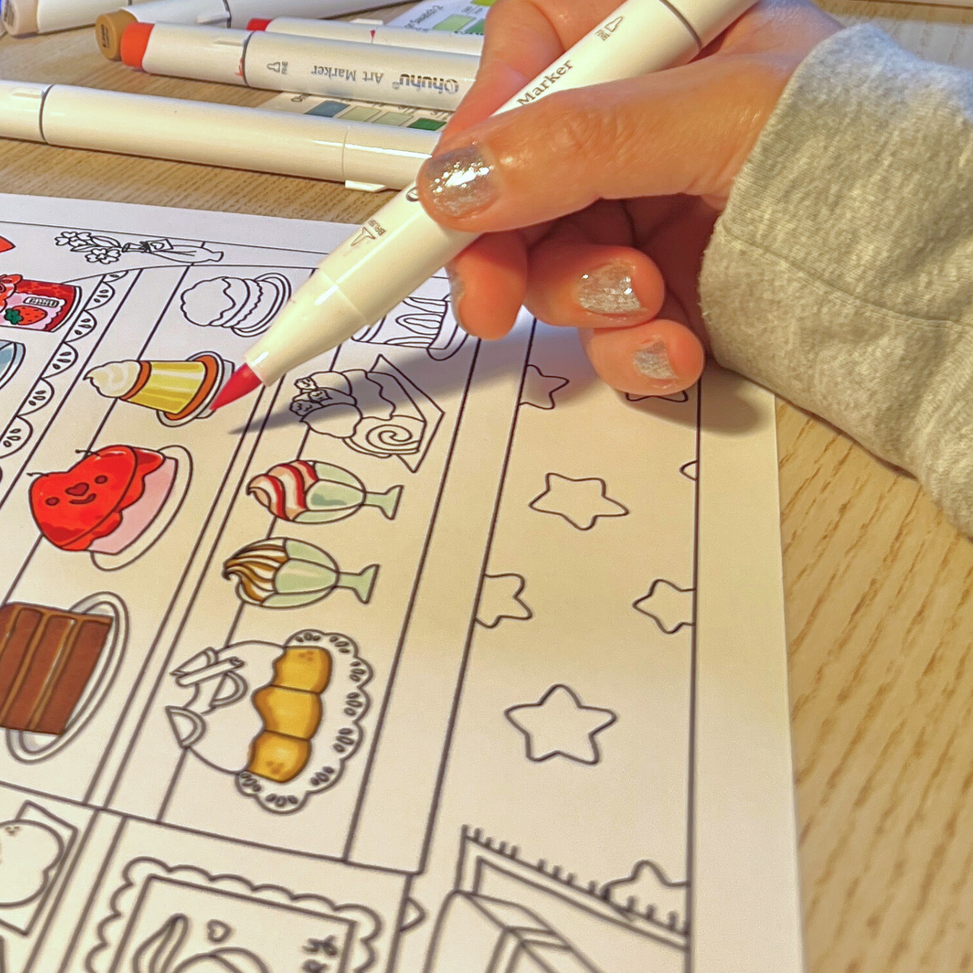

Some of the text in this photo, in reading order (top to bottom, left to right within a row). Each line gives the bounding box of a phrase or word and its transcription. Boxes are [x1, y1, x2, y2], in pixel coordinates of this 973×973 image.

[311, 64, 459, 95] Ohuhu Art Marker
[517, 59, 574, 106] Marker
